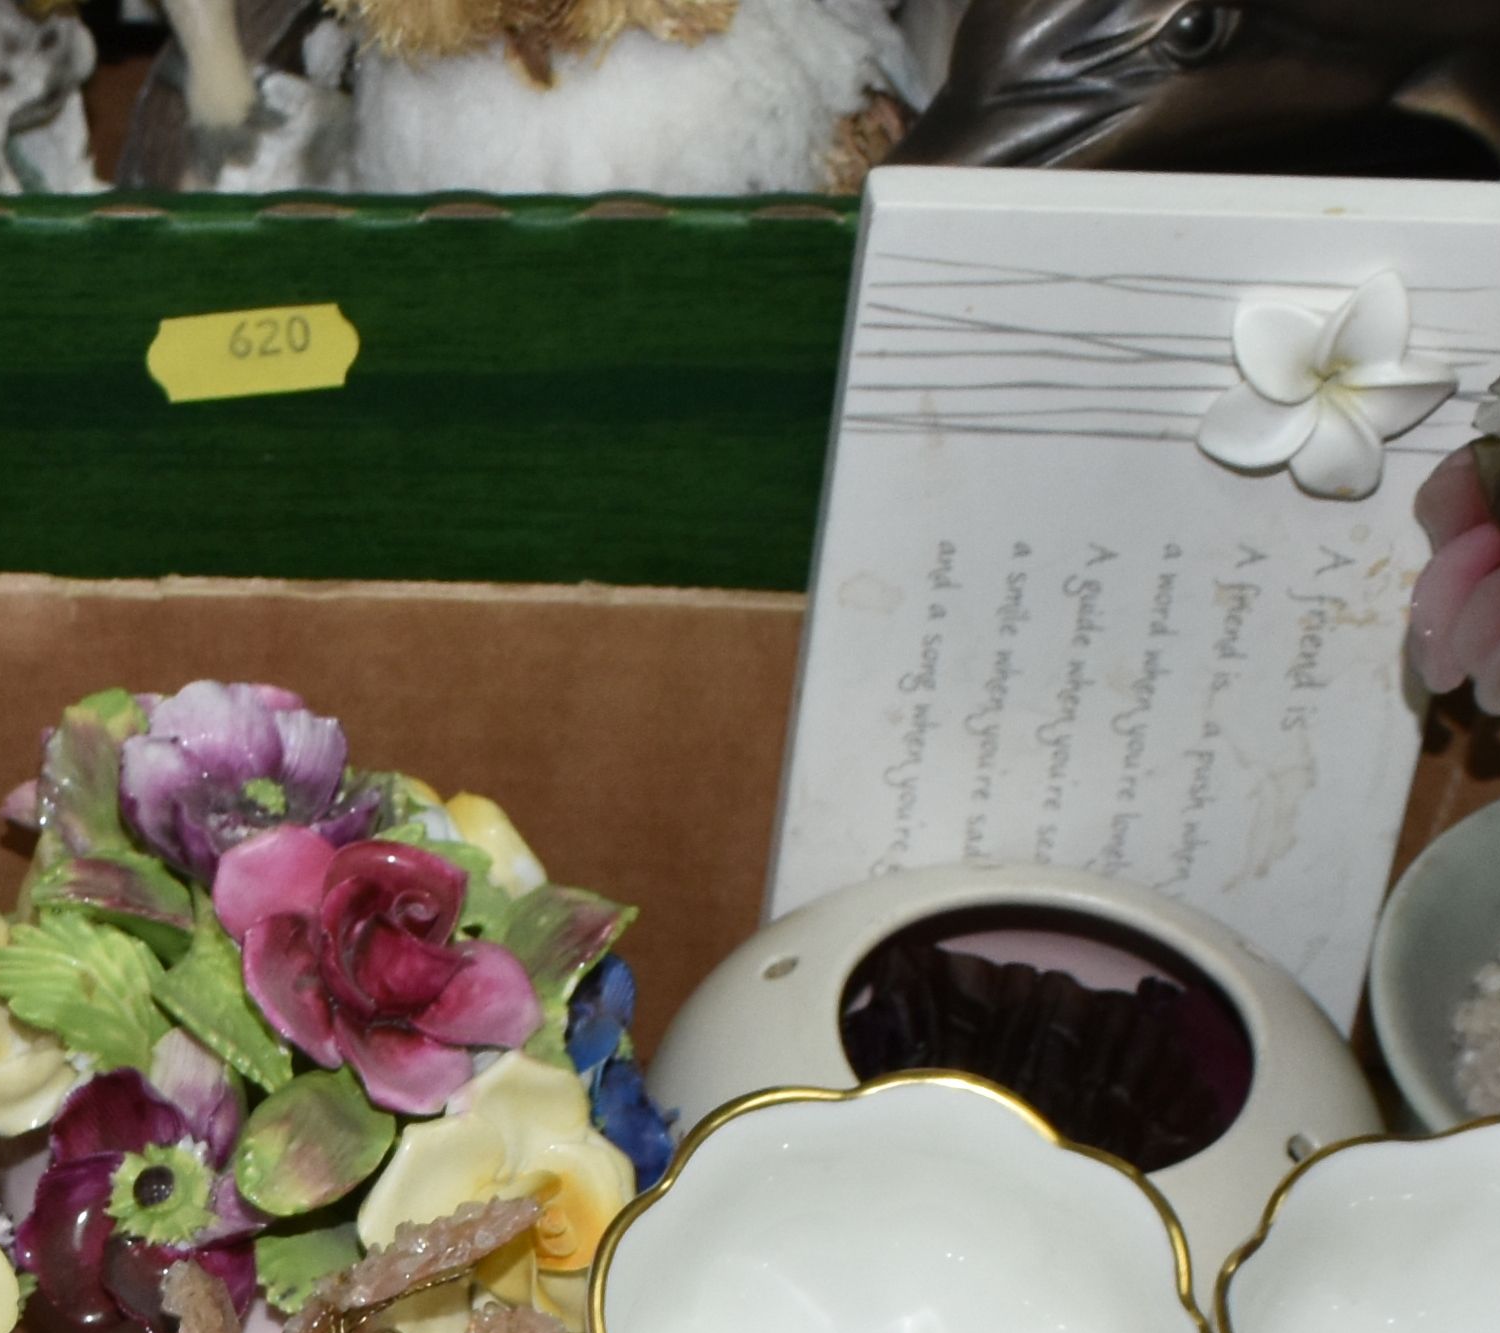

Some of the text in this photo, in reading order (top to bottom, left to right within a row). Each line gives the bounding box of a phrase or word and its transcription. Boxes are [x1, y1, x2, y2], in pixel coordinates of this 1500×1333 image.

[228, 313, 312, 360] 620
[927, 540, 961, 591] and
[1011, 541, 1032, 559] a
[1085, 542, 1119, 566] A
[1160, 542, 1183, 560] a
[1235, 543, 1270, 568] A
[927, 603, 947, 621] a
[997, 571, 1031, 636] smile
[1062, 573, 1105, 648] guide
[1147, 572, 1179, 637] word
[1214, 579, 1262, 660] friend
[898, 633, 944, 692] song
[1280, 545, 1356, 733] A friend is
[963, 719, 1008, 801] you're
[1110, 719, 1155, 801] you're
[1201, 720, 1221, 738] a
[1036, 730, 1078, 811] you're
[1181, 749, 1218, 812] push
[883, 772, 925, 853] you're
